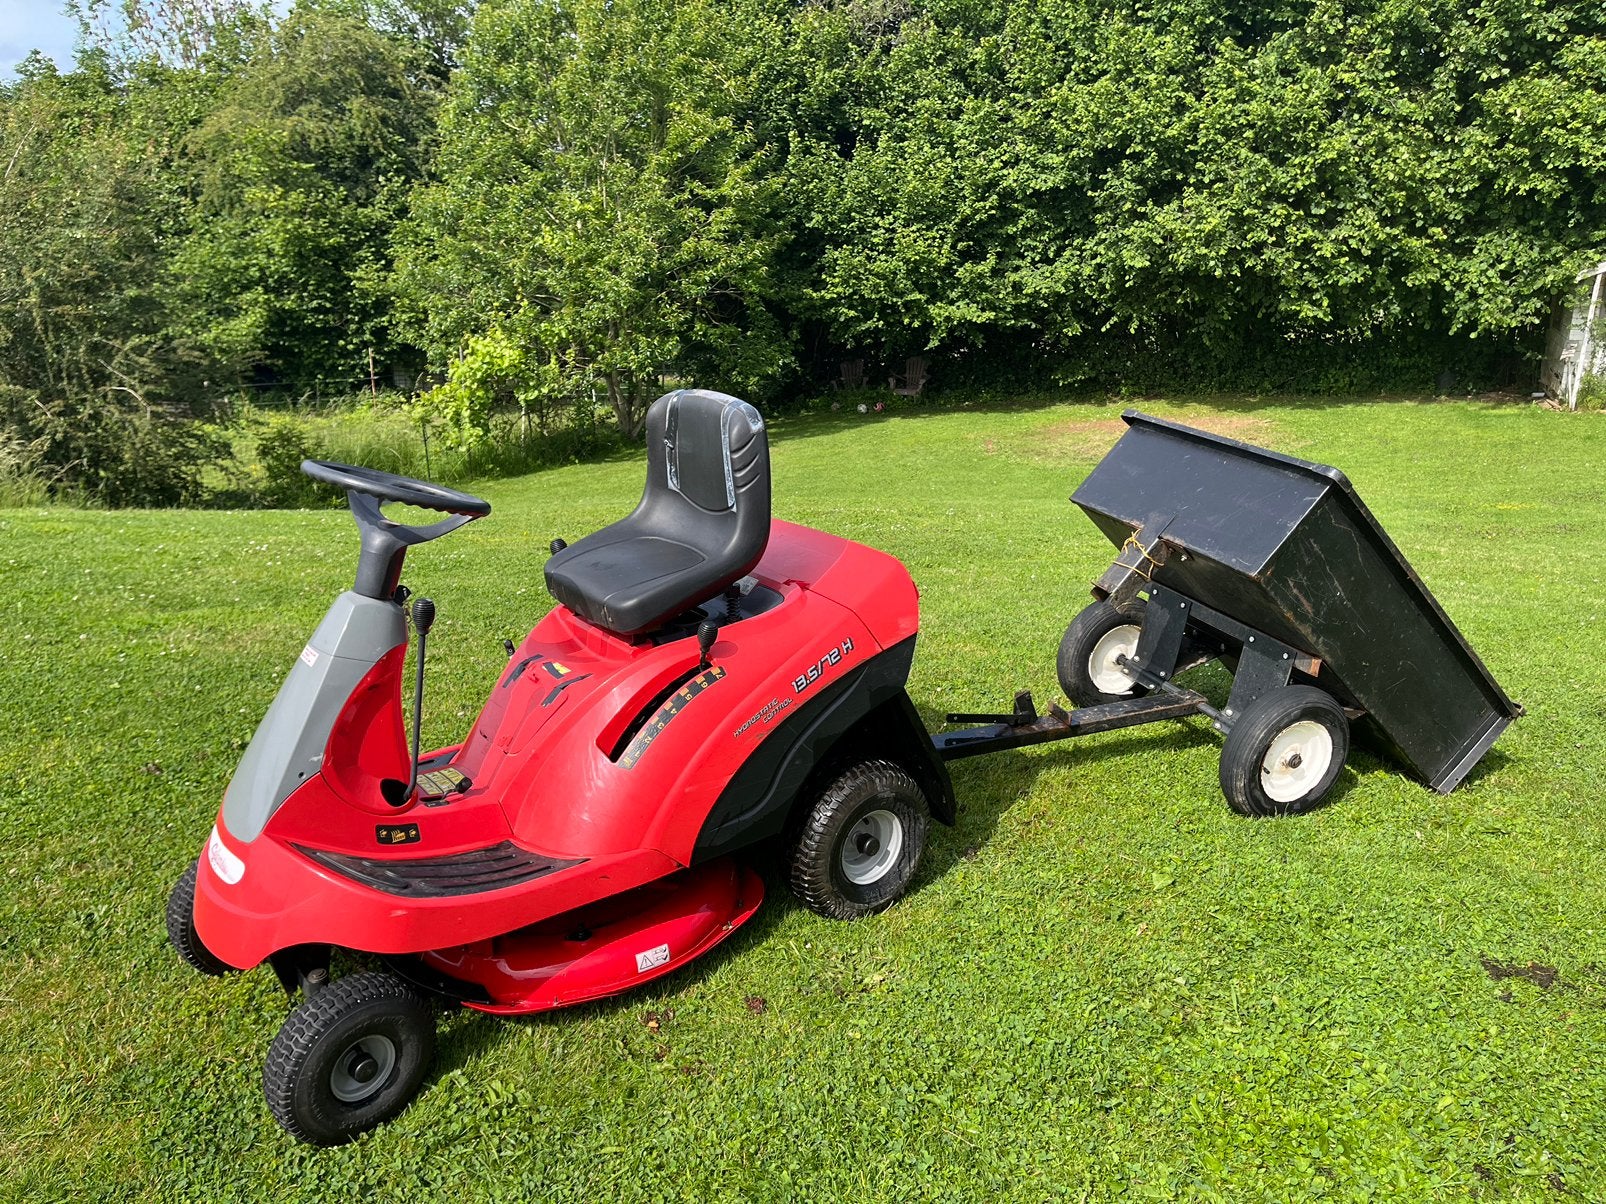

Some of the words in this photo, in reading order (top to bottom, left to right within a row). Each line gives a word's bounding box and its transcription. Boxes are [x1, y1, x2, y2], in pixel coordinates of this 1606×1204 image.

[791, 647, 842, 693] 13.5/72
[841, 637, 855, 655] H
[644, 736, 652, 744] 2
[657, 722, 665, 730] 3
[685, 693, 693, 701] 5
[700, 681, 708, 689] 6
[733, 697, 779, 738] HYDROSTATIC
[763, 697, 793, 724] CONTROL
